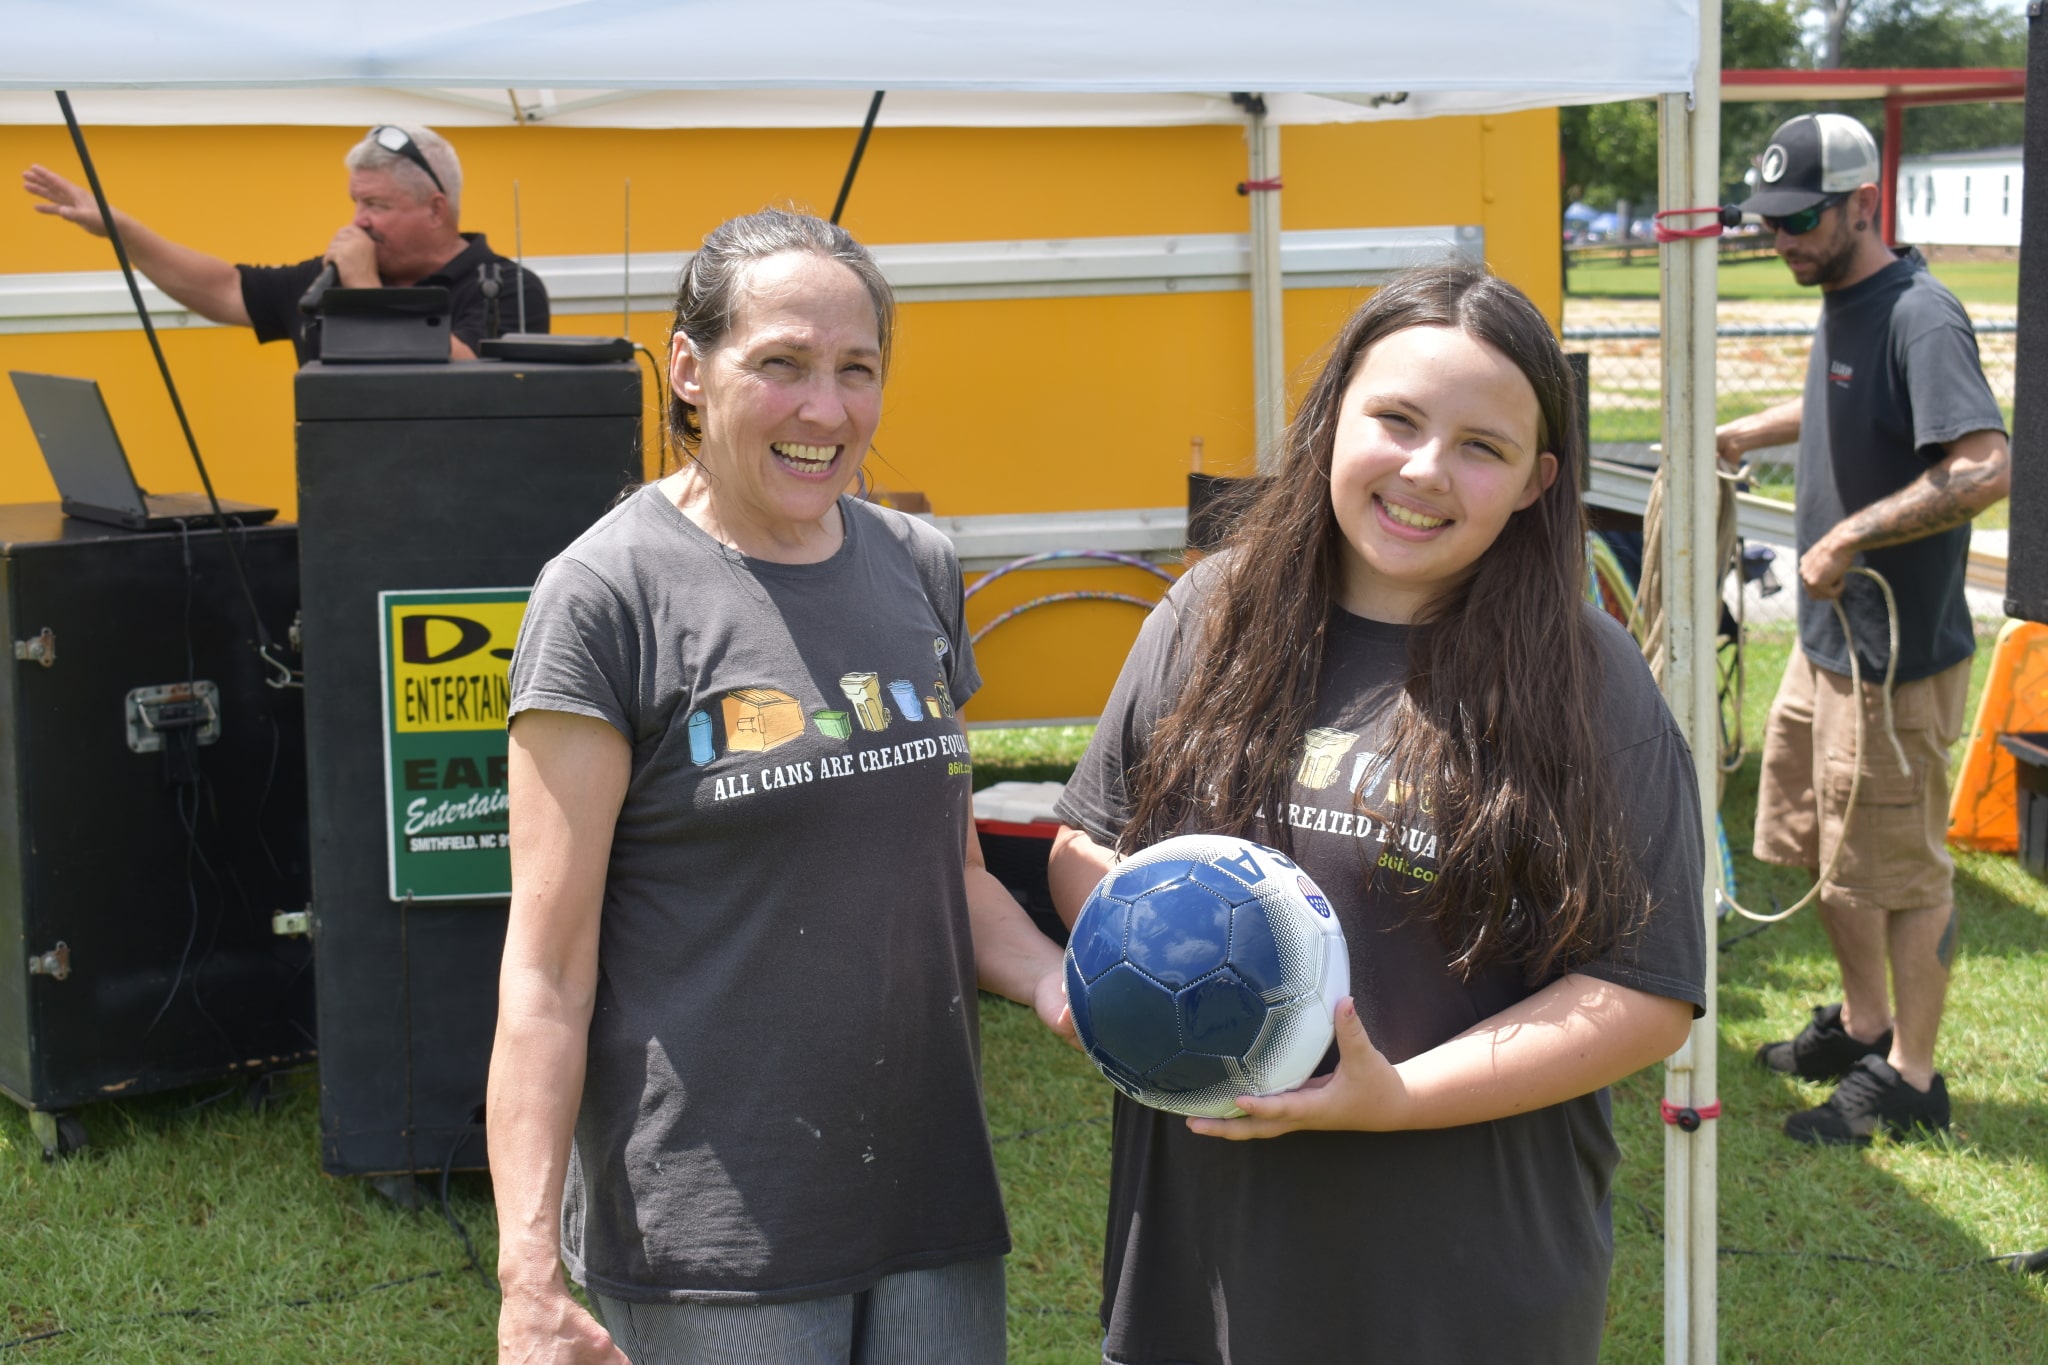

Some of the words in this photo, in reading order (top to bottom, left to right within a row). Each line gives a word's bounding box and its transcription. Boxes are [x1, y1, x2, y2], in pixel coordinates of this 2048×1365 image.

[714, 773, 755, 801] ALL
[761, 761, 814, 791] CANS
[820, 754, 854, 779] ARE
[859, 738, 937, 773] CREATED
[939, 734, 970, 758] EQUA
[1277, 801, 1372, 838] REATED
[480, 833, 497, 848] NC
[1377, 852, 1440, 882] 86it.co
